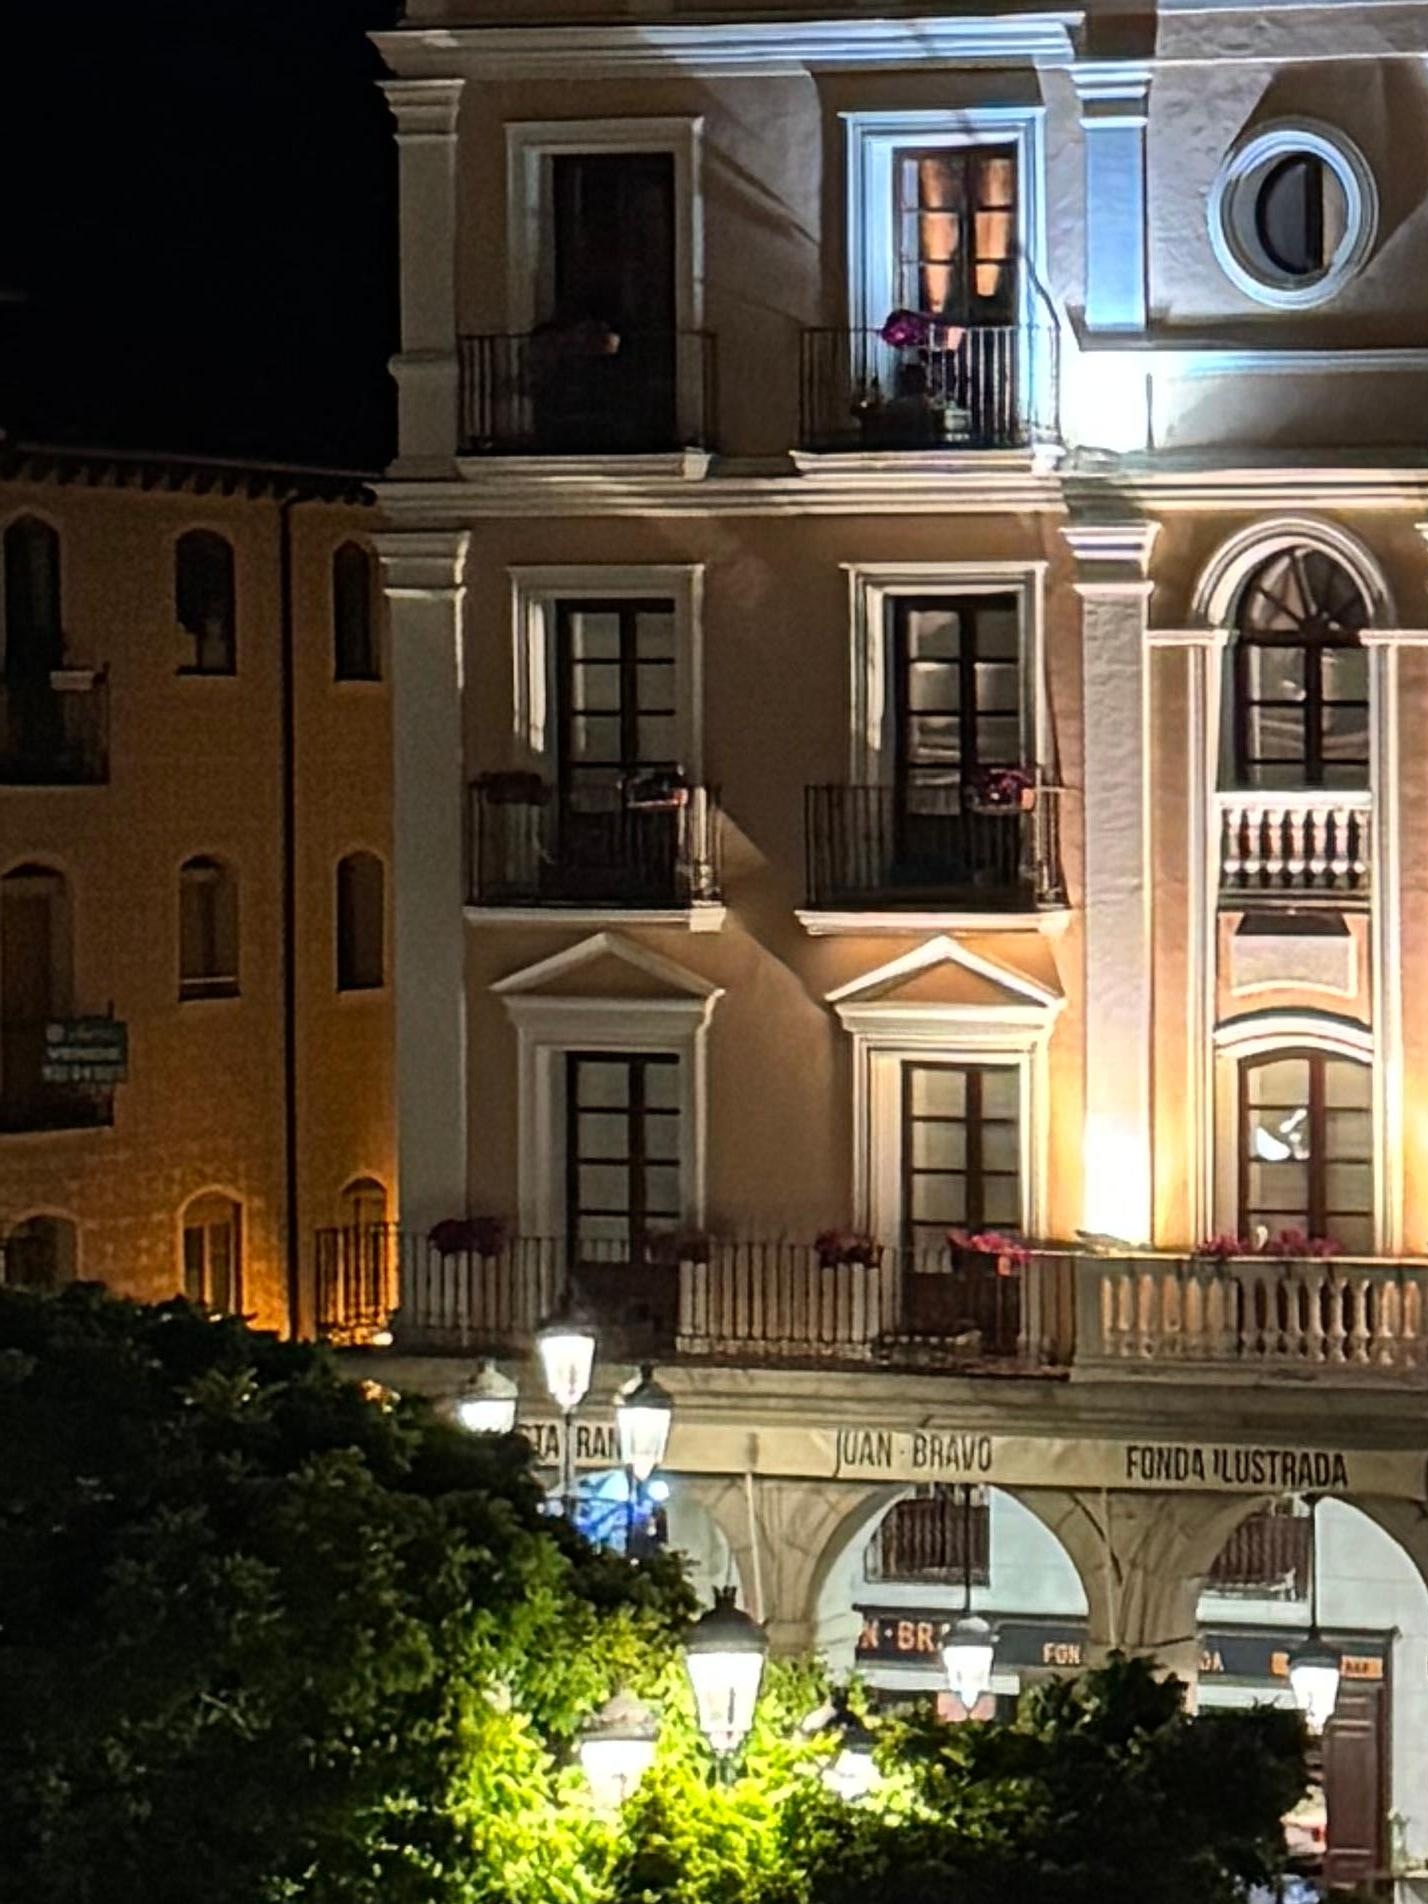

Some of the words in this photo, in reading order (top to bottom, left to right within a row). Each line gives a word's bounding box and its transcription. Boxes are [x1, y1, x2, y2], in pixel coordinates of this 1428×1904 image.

[832, 1428, 892, 1478] JUAN
[913, 1432, 992, 1473] BRAVO
[1126, 1445, 1206, 1482] FONDA
[1213, 1448, 1348, 1488] ILUSTRADA
